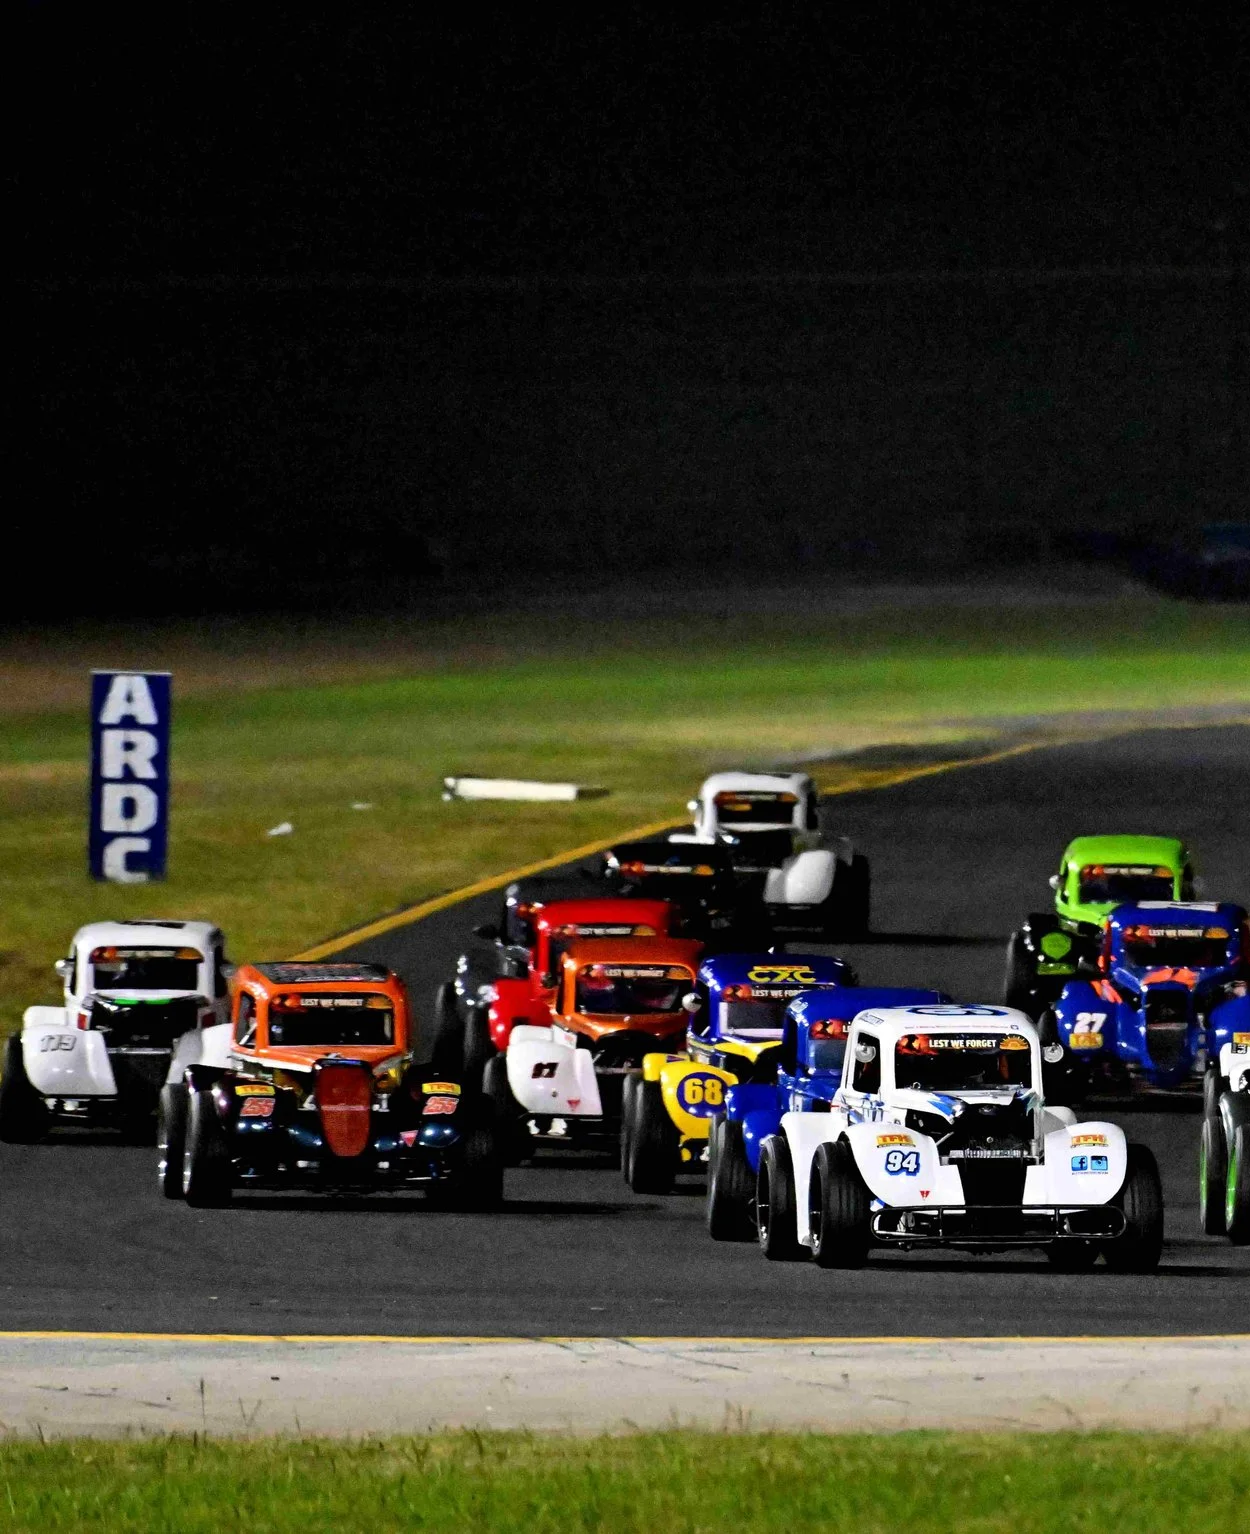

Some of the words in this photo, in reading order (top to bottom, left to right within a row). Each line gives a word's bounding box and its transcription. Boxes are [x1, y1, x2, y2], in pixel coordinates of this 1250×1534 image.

[99, 675, 159, 883] ARDC
[748, 971, 816, 983] CXC
[770, 990, 783, 998] WE
[1074, 1012, 1107, 1034] 27
[929, 1040, 949, 1048] LEST
[950, 1040, 965, 1048] WE
[966, 1039, 997, 1048] FORGET
[684, 1078, 723, 1105] 68
[885, 1150, 920, 1176] 94
